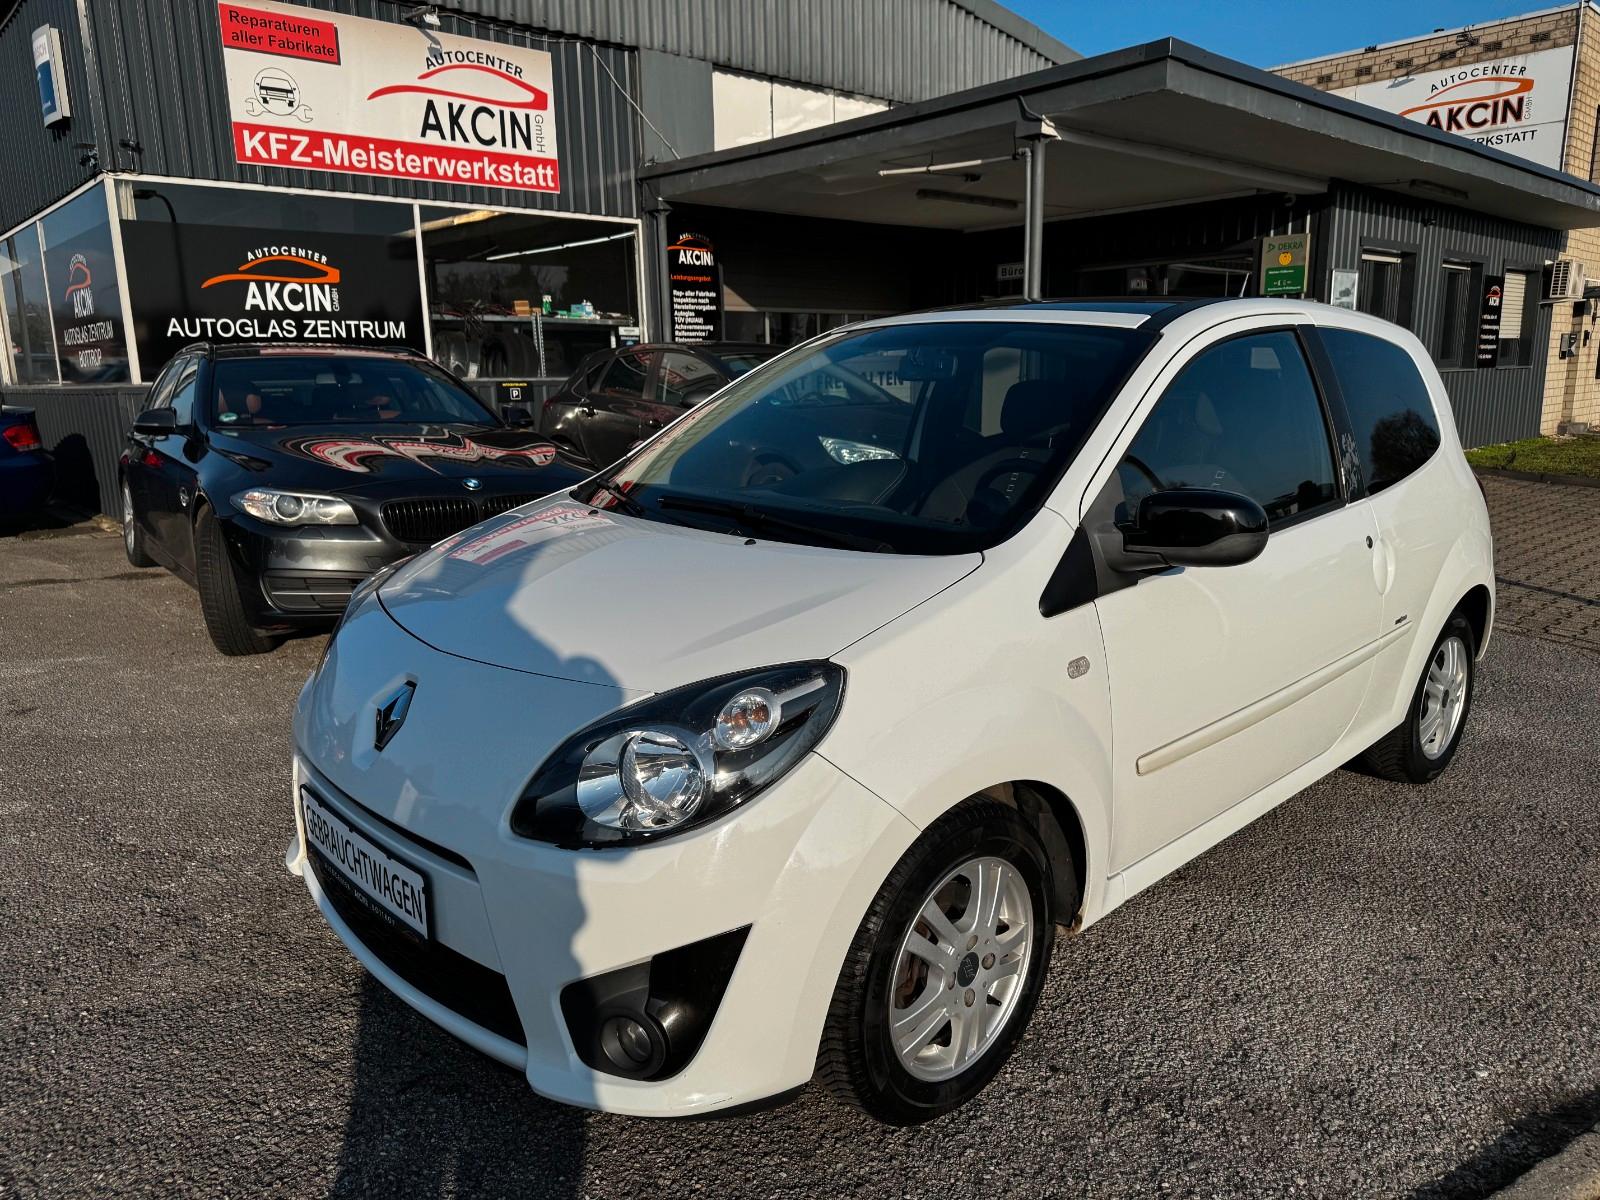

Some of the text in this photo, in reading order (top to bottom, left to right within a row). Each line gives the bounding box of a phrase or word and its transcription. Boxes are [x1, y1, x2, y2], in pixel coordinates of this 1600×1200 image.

[229, 10, 320, 37] Reparaturen
[231, 30, 335, 57] aller Fabrikate
[425, 51, 523, 79] AUTOCENTER
[1431, 65, 1526, 93] AUTOCENTER
[420, 99, 533, 151] AKCIN
[1426, 96, 1525, 132] AKCIN
[534, 114, 546, 153] GmbH
[1473, 129, 1538, 147] RKSTATT
[242, 129, 555, 188] KFZ-Meisterwerkstatt
[247, 246, 328, 265] AUTOCENTER
[679, 249, 711, 266] AKCIN
[1278, 241, 1303, 251] DEKRA
[1001, 266, 1024, 277] Büro
[244, 281, 332, 312] AKCIN
[87, 319, 114, 342] ZENTRUM
[167, 317, 407, 339] AUTOGLAS ZENTRUM
[305, 804, 424, 925] GEBRAUCHTWAGEN
